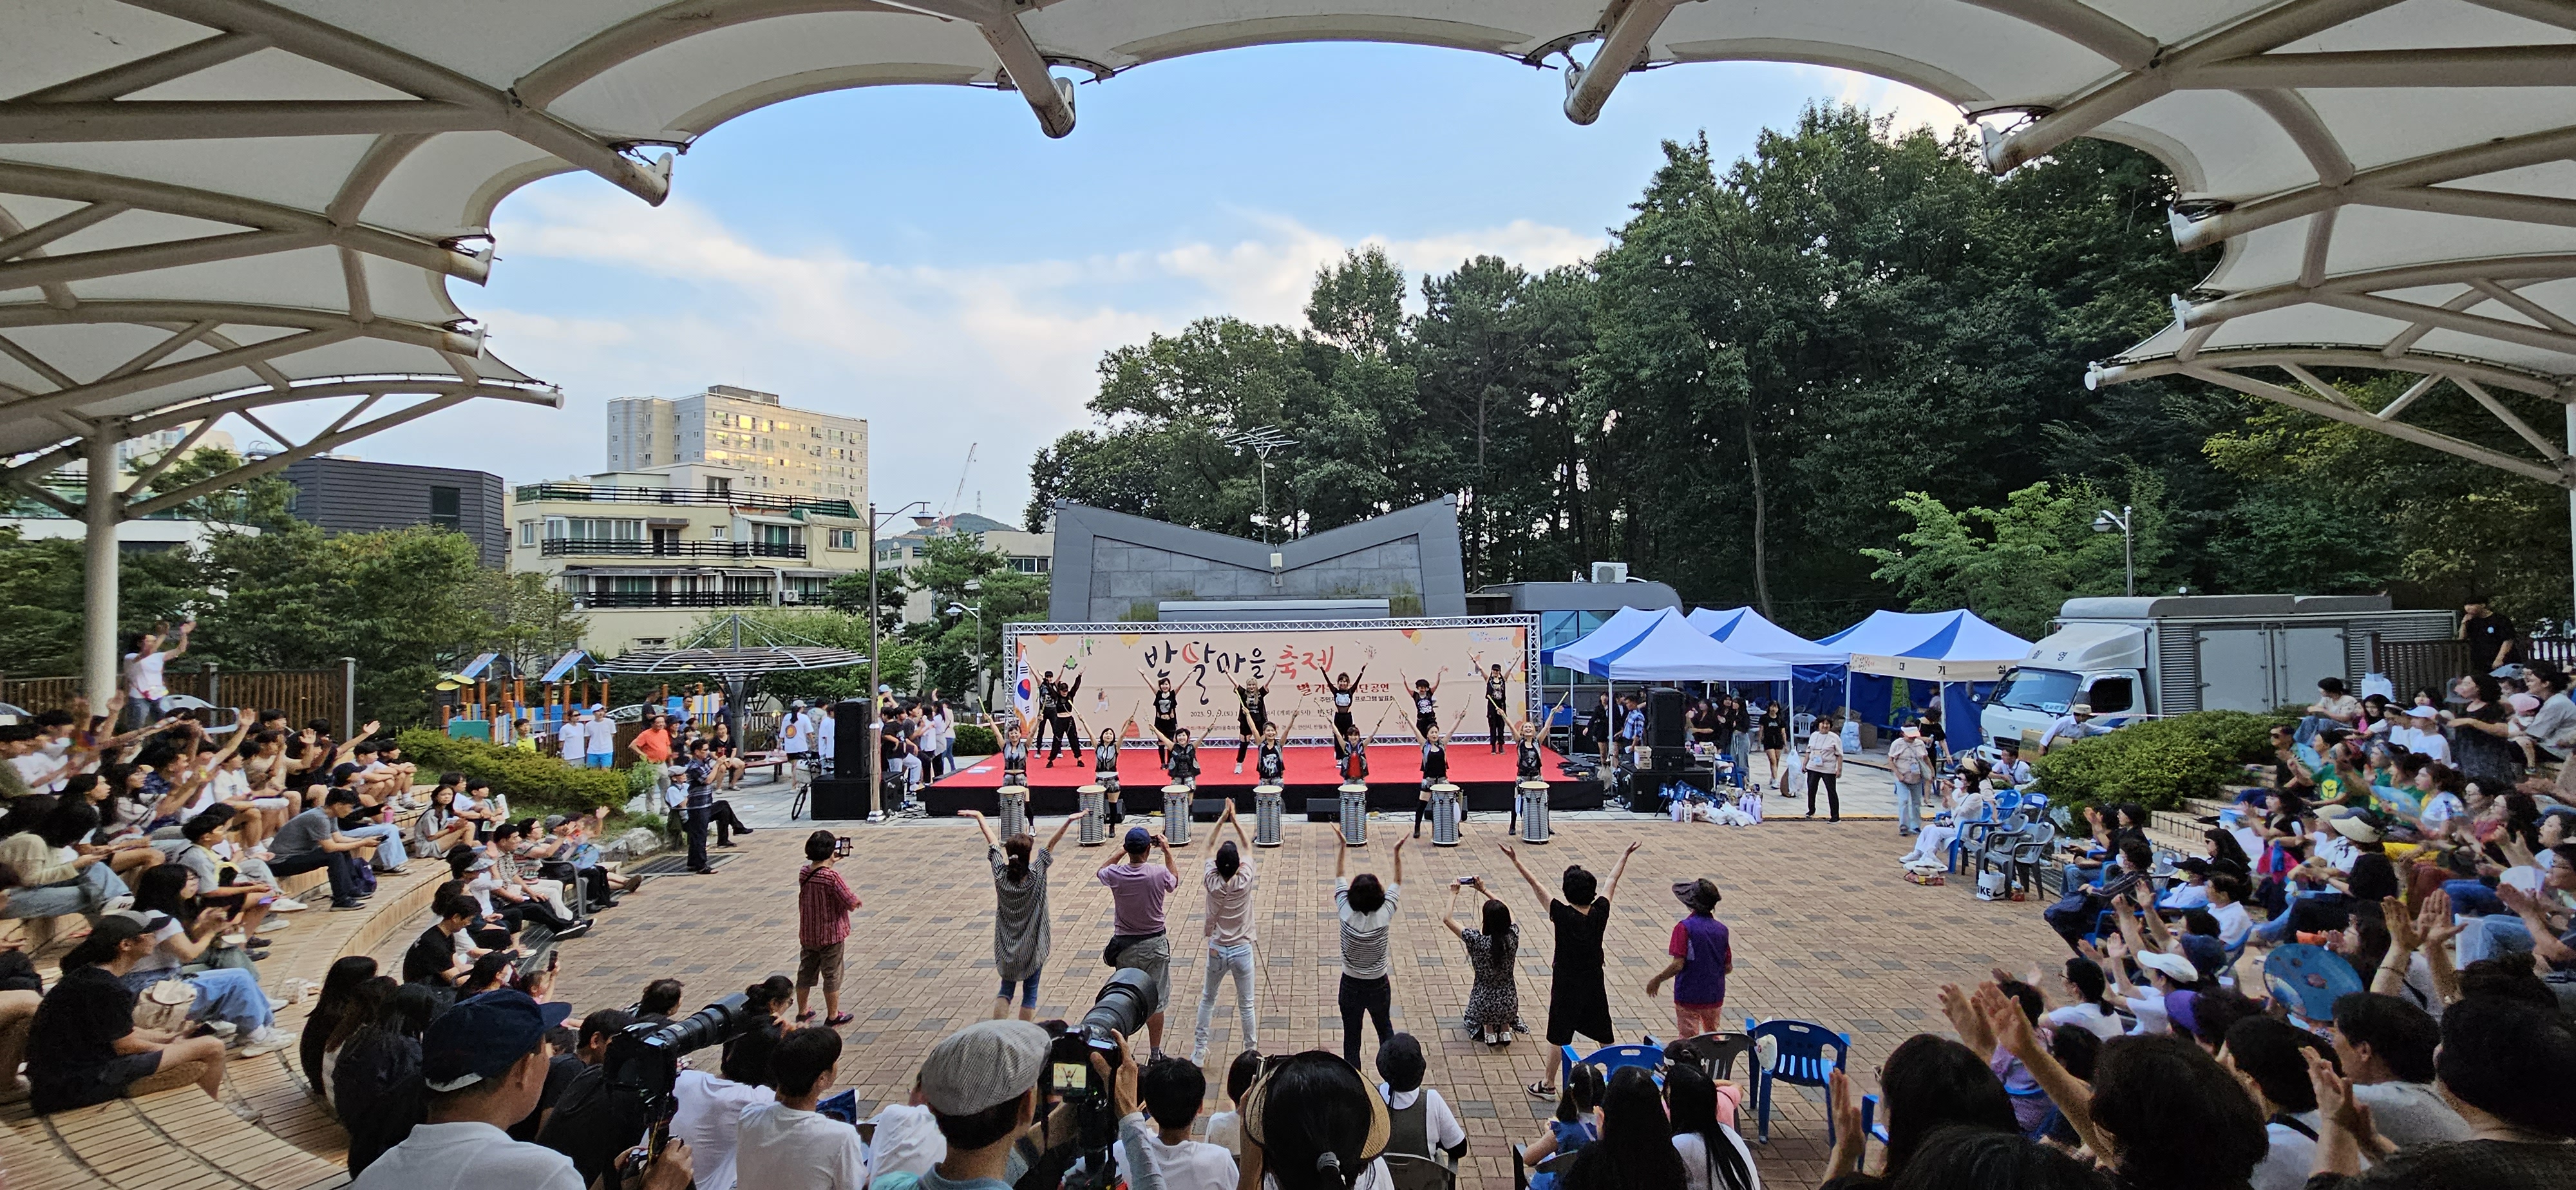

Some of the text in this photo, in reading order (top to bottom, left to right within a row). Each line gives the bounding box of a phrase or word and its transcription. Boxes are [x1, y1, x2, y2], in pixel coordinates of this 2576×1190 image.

[1145, 640, 1334, 705] 반달마을 축제
[1296, 682, 1312, 696] 별
[1370, 683, 1389, 693] 공연
